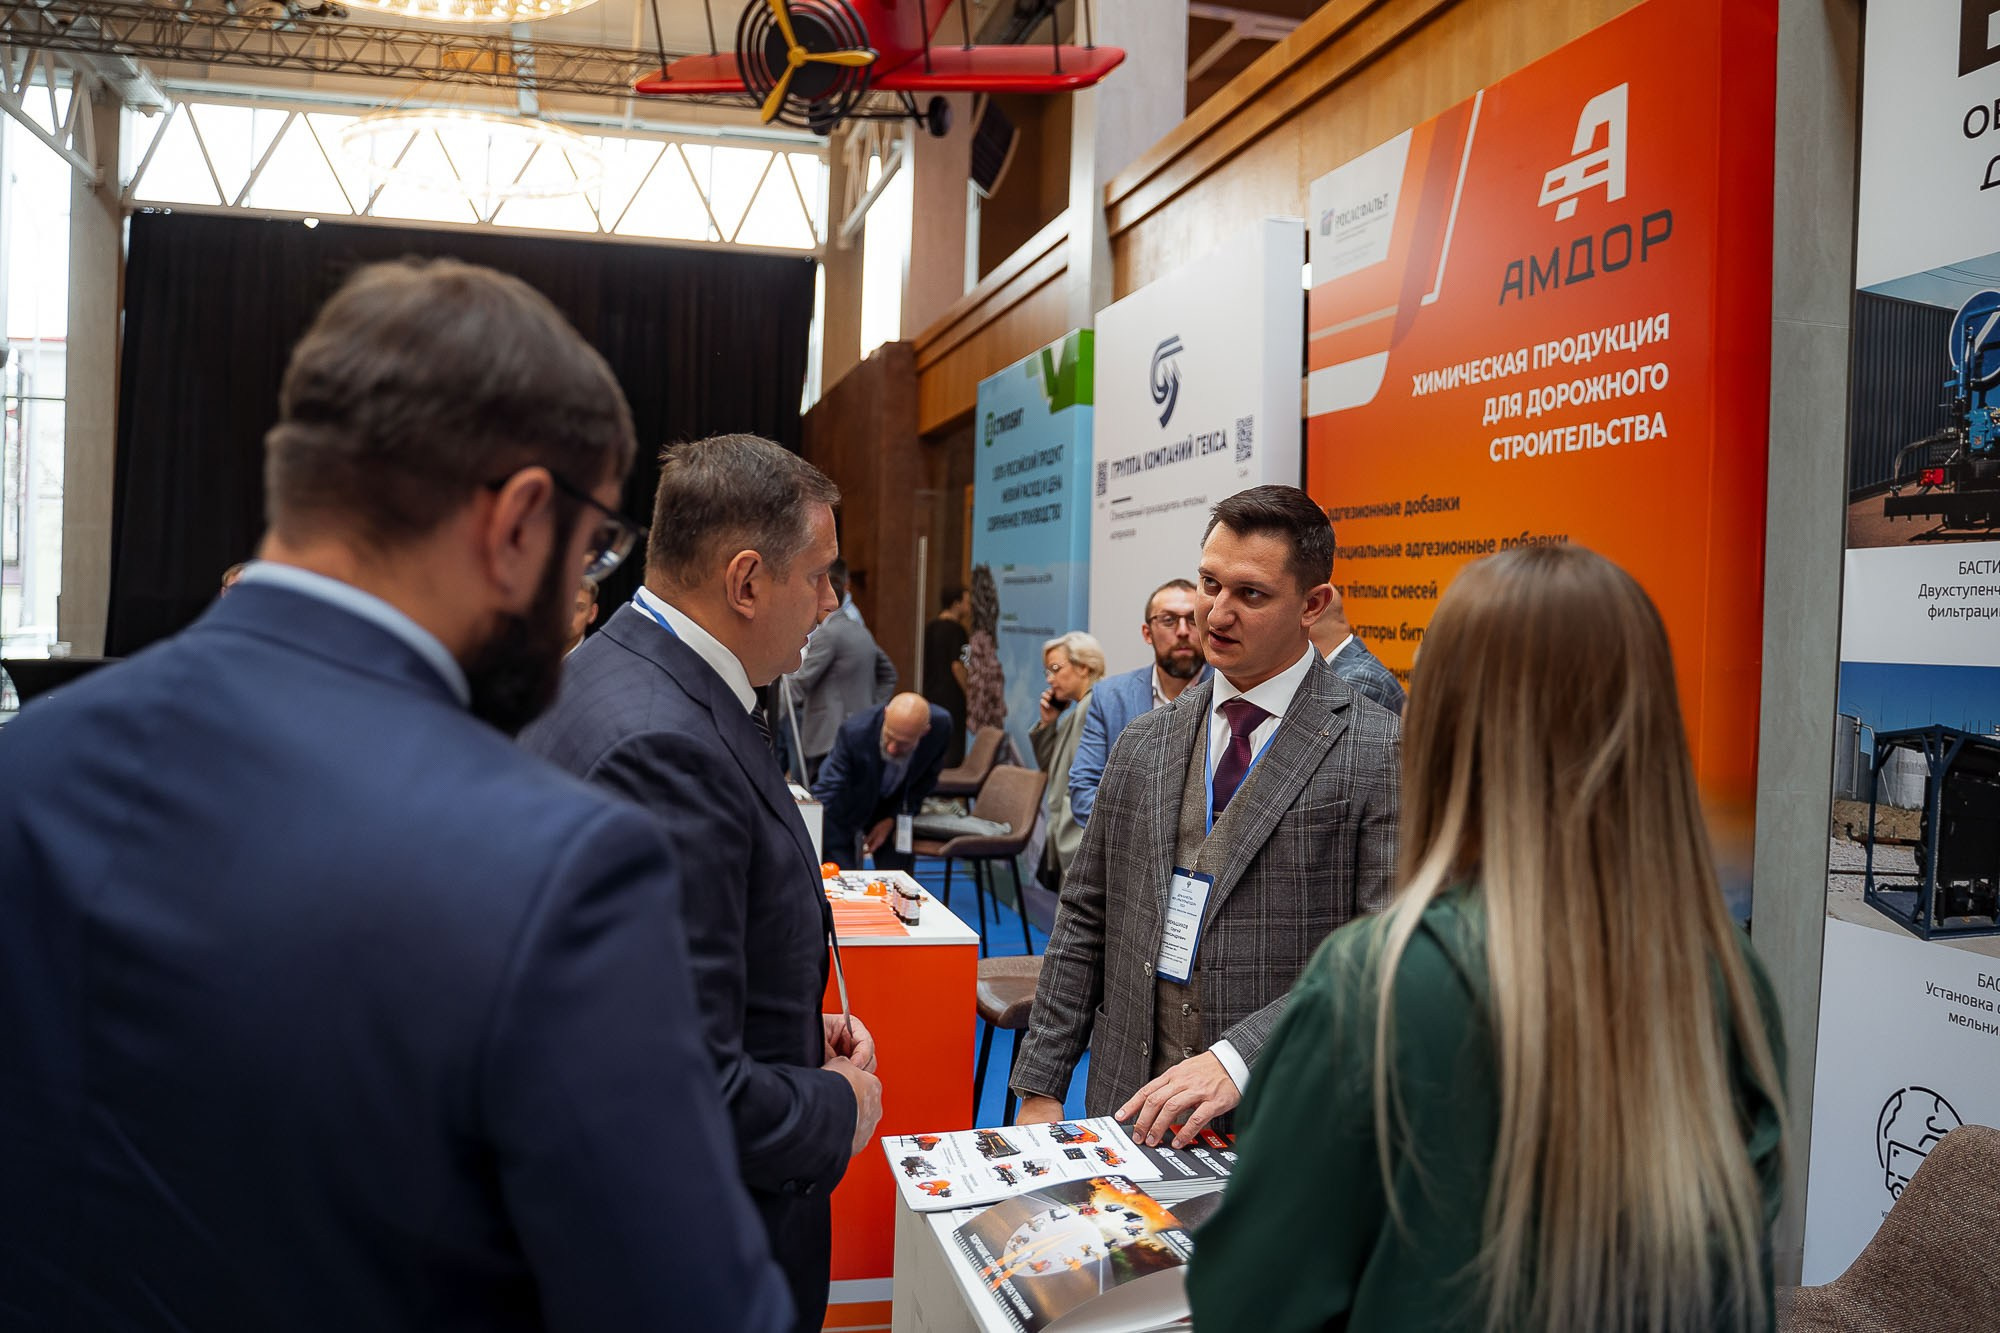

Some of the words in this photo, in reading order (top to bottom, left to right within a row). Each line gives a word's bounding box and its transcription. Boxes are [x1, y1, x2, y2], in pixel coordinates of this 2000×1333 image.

[1498, 208, 1673, 306] АМДОР
[1411, 348, 1528, 397] ХИМИЧЕСКАЯ
[1532, 312, 1670, 366] ПРОДУКЦИЯ
[1482, 392, 1522, 426] ДЛЯ
[1525, 362, 1669, 419] ДОРОЖНОГО
[1489, 411, 1668, 462] СТРОИТЕЛЬСТВА
[1110, 455, 1141, 480] ГРУППА
[1144, 433, 1194, 472] КОМПАНИЙ
[1404, 493, 1461, 517] добавки
[1335, 542, 1402, 560] пециальные
[1405, 537, 1496, 558] адгезионные
[1347, 580, 1388, 599] тёплых
[1391, 580, 1438, 599] смесей
[1927, 604, 2000, 621] фильтраци
[1925, 980, 1995, 1013] Установка
[1104, 1175, 1137, 1195] 2024
[1000, 1278, 1016, 1295] ДЕЛО
[1010, 1290, 1033, 1320] ТЕХНИКИ
